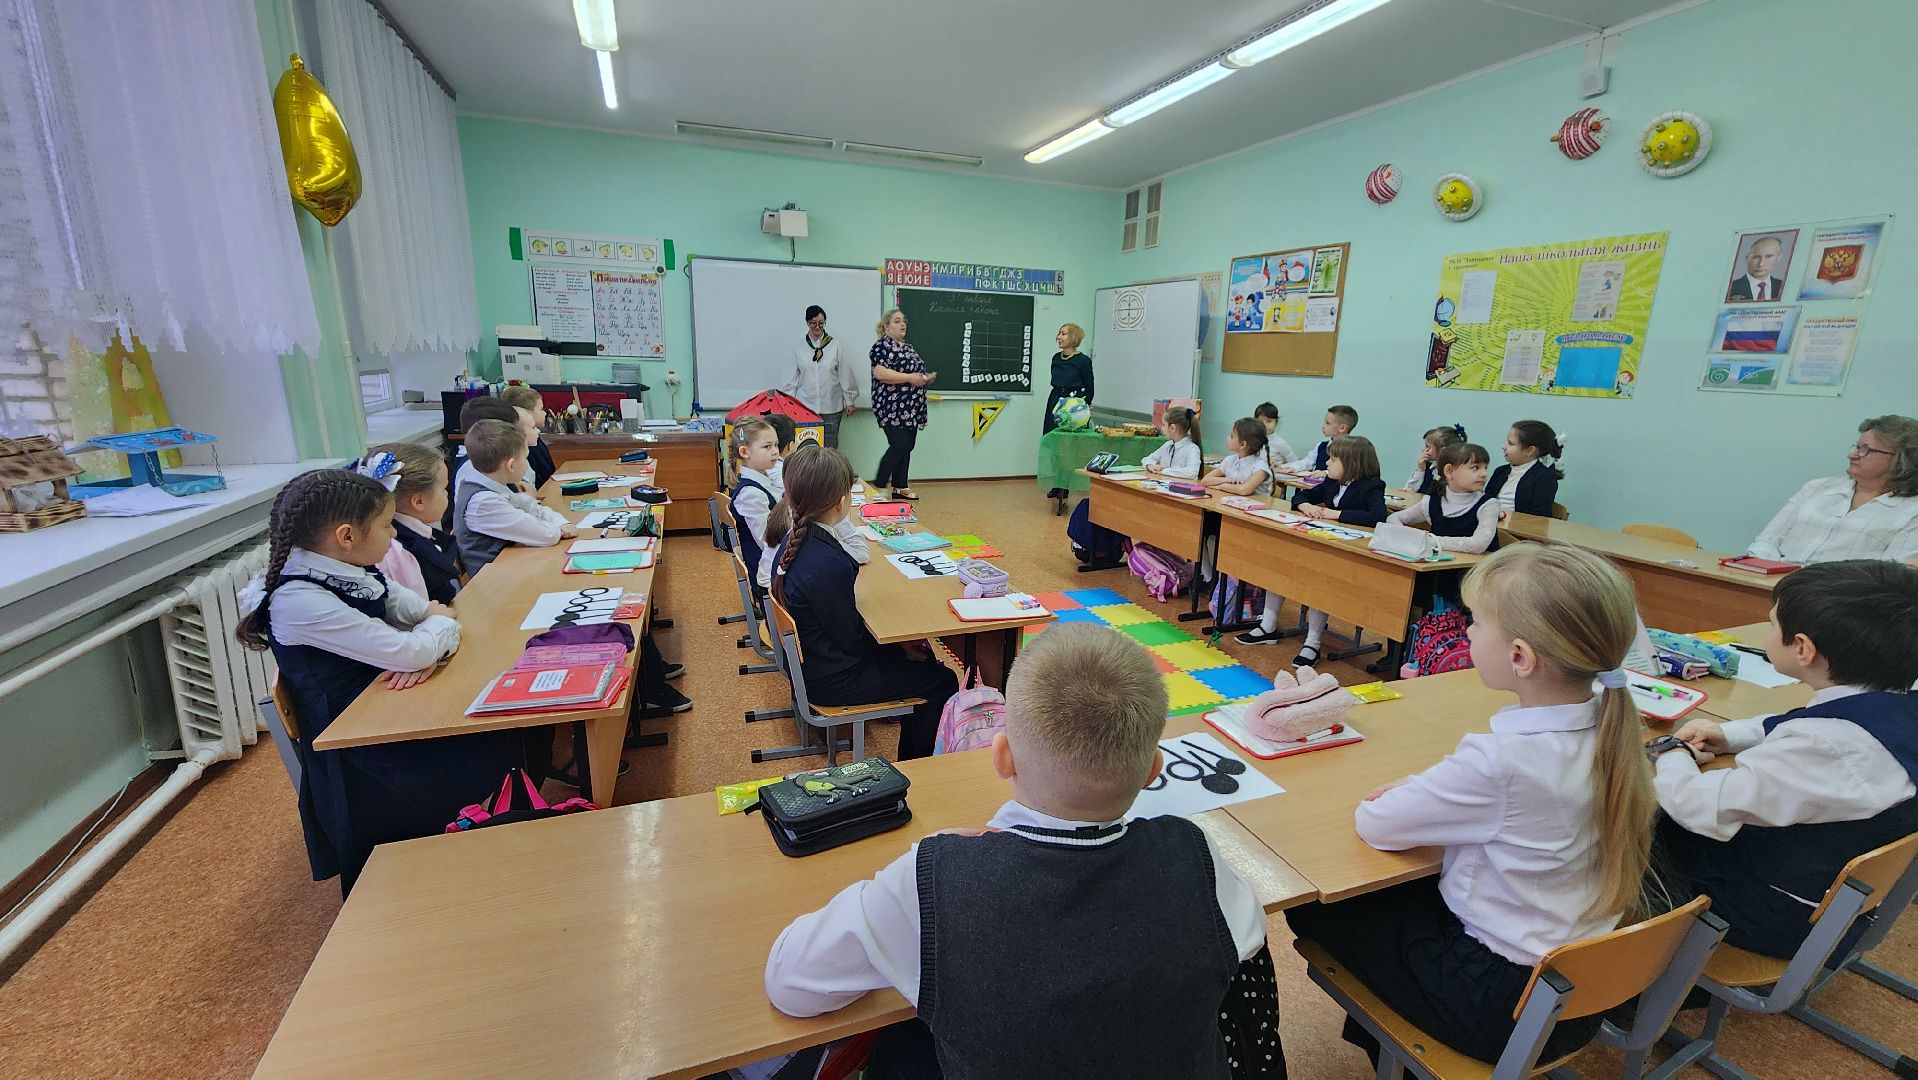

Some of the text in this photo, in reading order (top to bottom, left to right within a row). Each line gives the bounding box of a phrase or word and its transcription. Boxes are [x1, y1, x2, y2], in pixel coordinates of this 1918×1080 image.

[1499, 240, 1661, 265] Наша школьная жизнь
